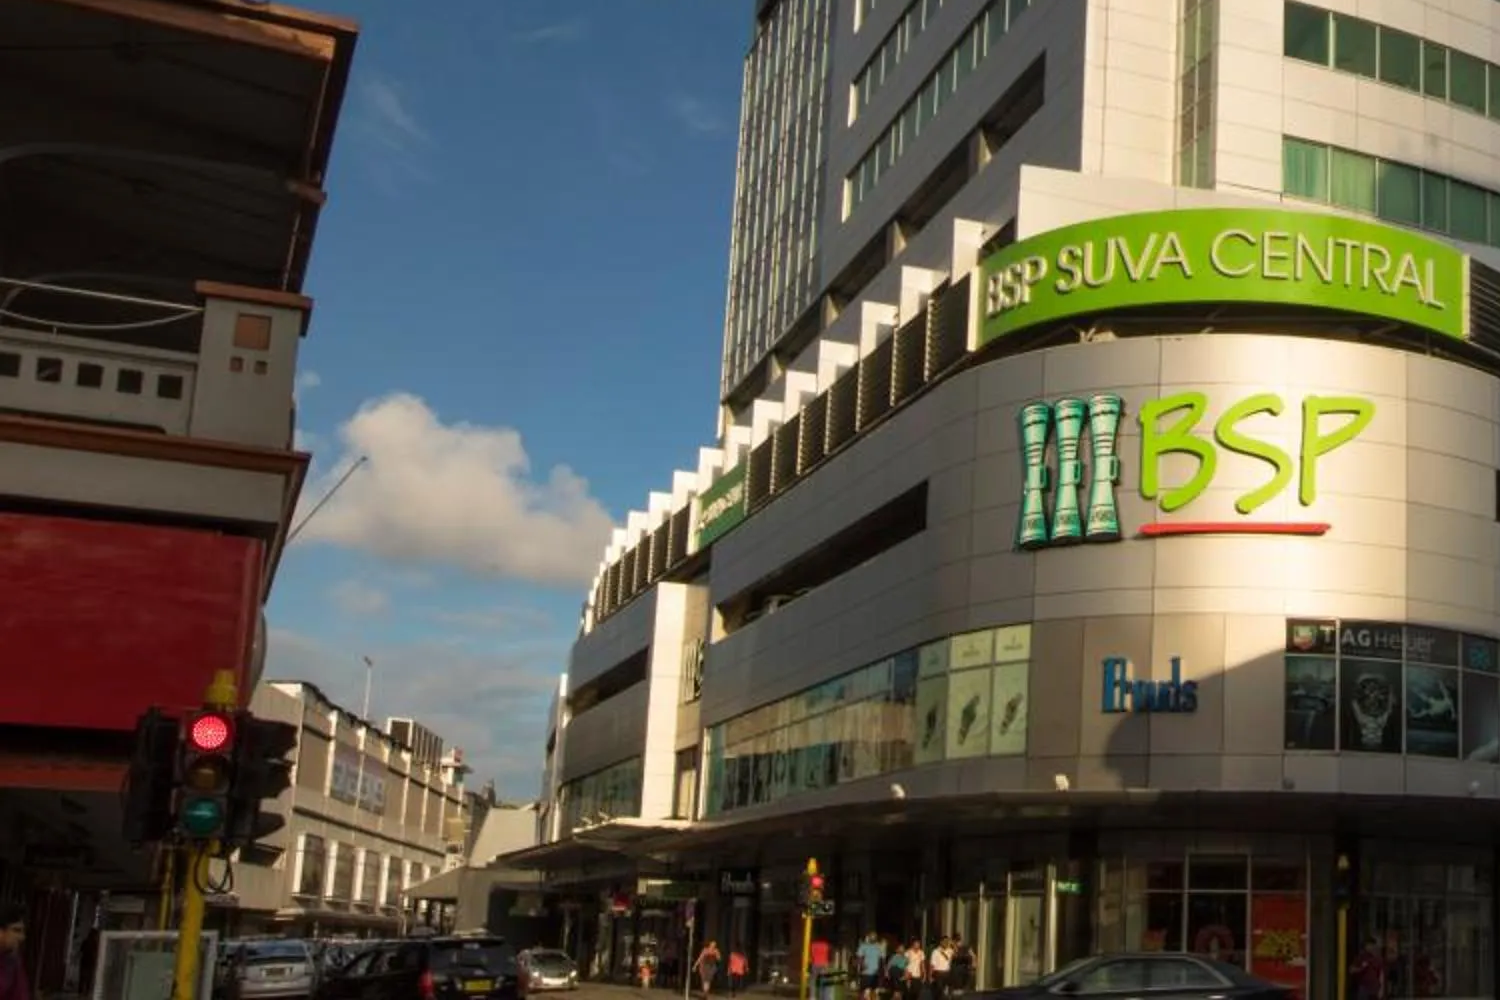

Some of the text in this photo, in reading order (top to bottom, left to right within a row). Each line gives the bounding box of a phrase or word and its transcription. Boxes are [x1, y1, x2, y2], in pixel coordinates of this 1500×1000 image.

[986, 229, 1446, 317] BSP SUVA CENTRAL
[1137, 391, 1376, 514] BSP
[1319, 625, 1372, 648] TAG
